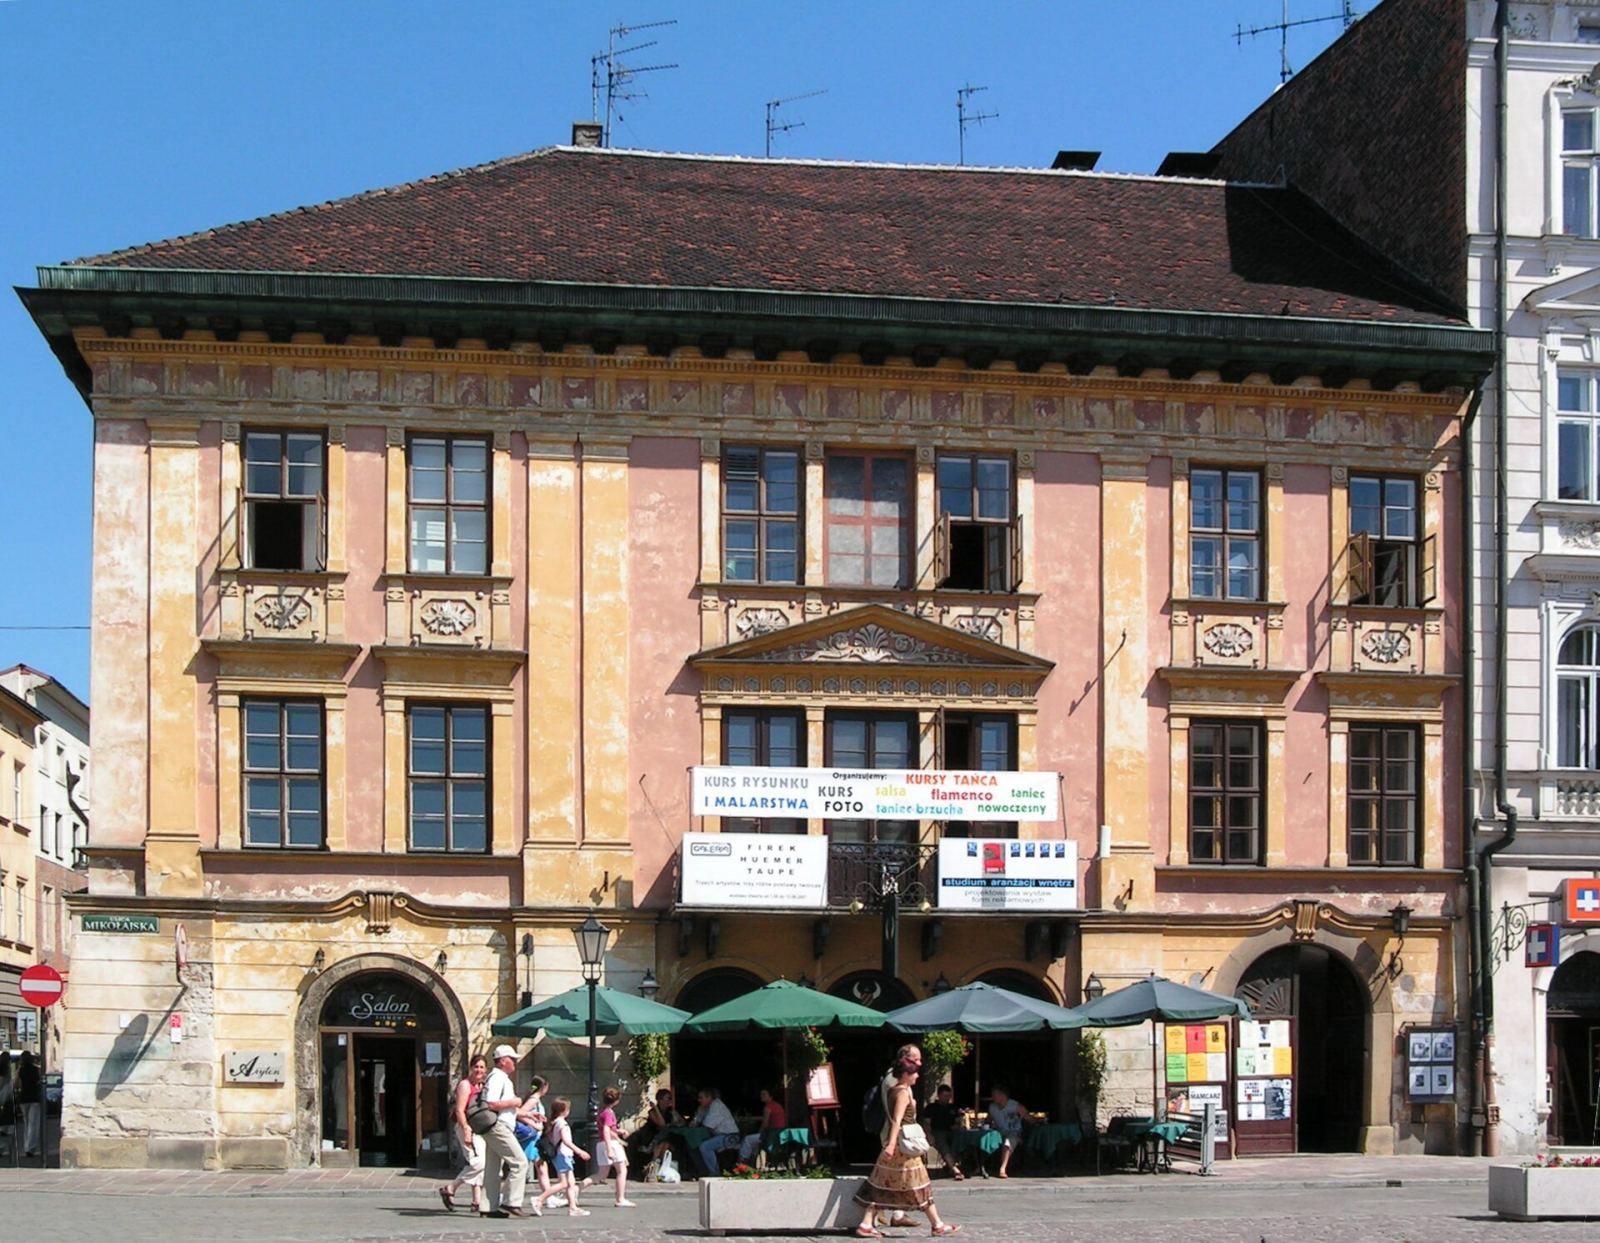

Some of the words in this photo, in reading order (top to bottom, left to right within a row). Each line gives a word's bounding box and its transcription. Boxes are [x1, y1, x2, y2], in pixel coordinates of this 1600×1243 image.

[704, 776, 737, 788] KURS
[742, 777, 809, 789] RYSUNKU
[906, 774, 947, 785] KURSY
[953, 773, 997, 786] TAŃCA
[818, 786, 854, 797] KURS
[875, 785, 907, 796] salsa
[931, 788, 993, 801] flamenco
[1011, 788, 1046, 799] taniec
[714, 797, 809, 809] MALARSTWA
[824, 801, 864, 812] FOTO
[876, 803, 912, 814] taniec
[915, 803, 964, 815] brzucha
[977, 804, 1046, 815] nowoczesny
[747, 844, 796, 852] FIREK
[740, 856, 803, 864] HUEMER
[747, 868, 795, 876] TAUPE
[944, 878, 987, 887] studium
[85, 921, 156, 932] MIKOŁAJSKA
[351, 993, 410, 1019] Salon
